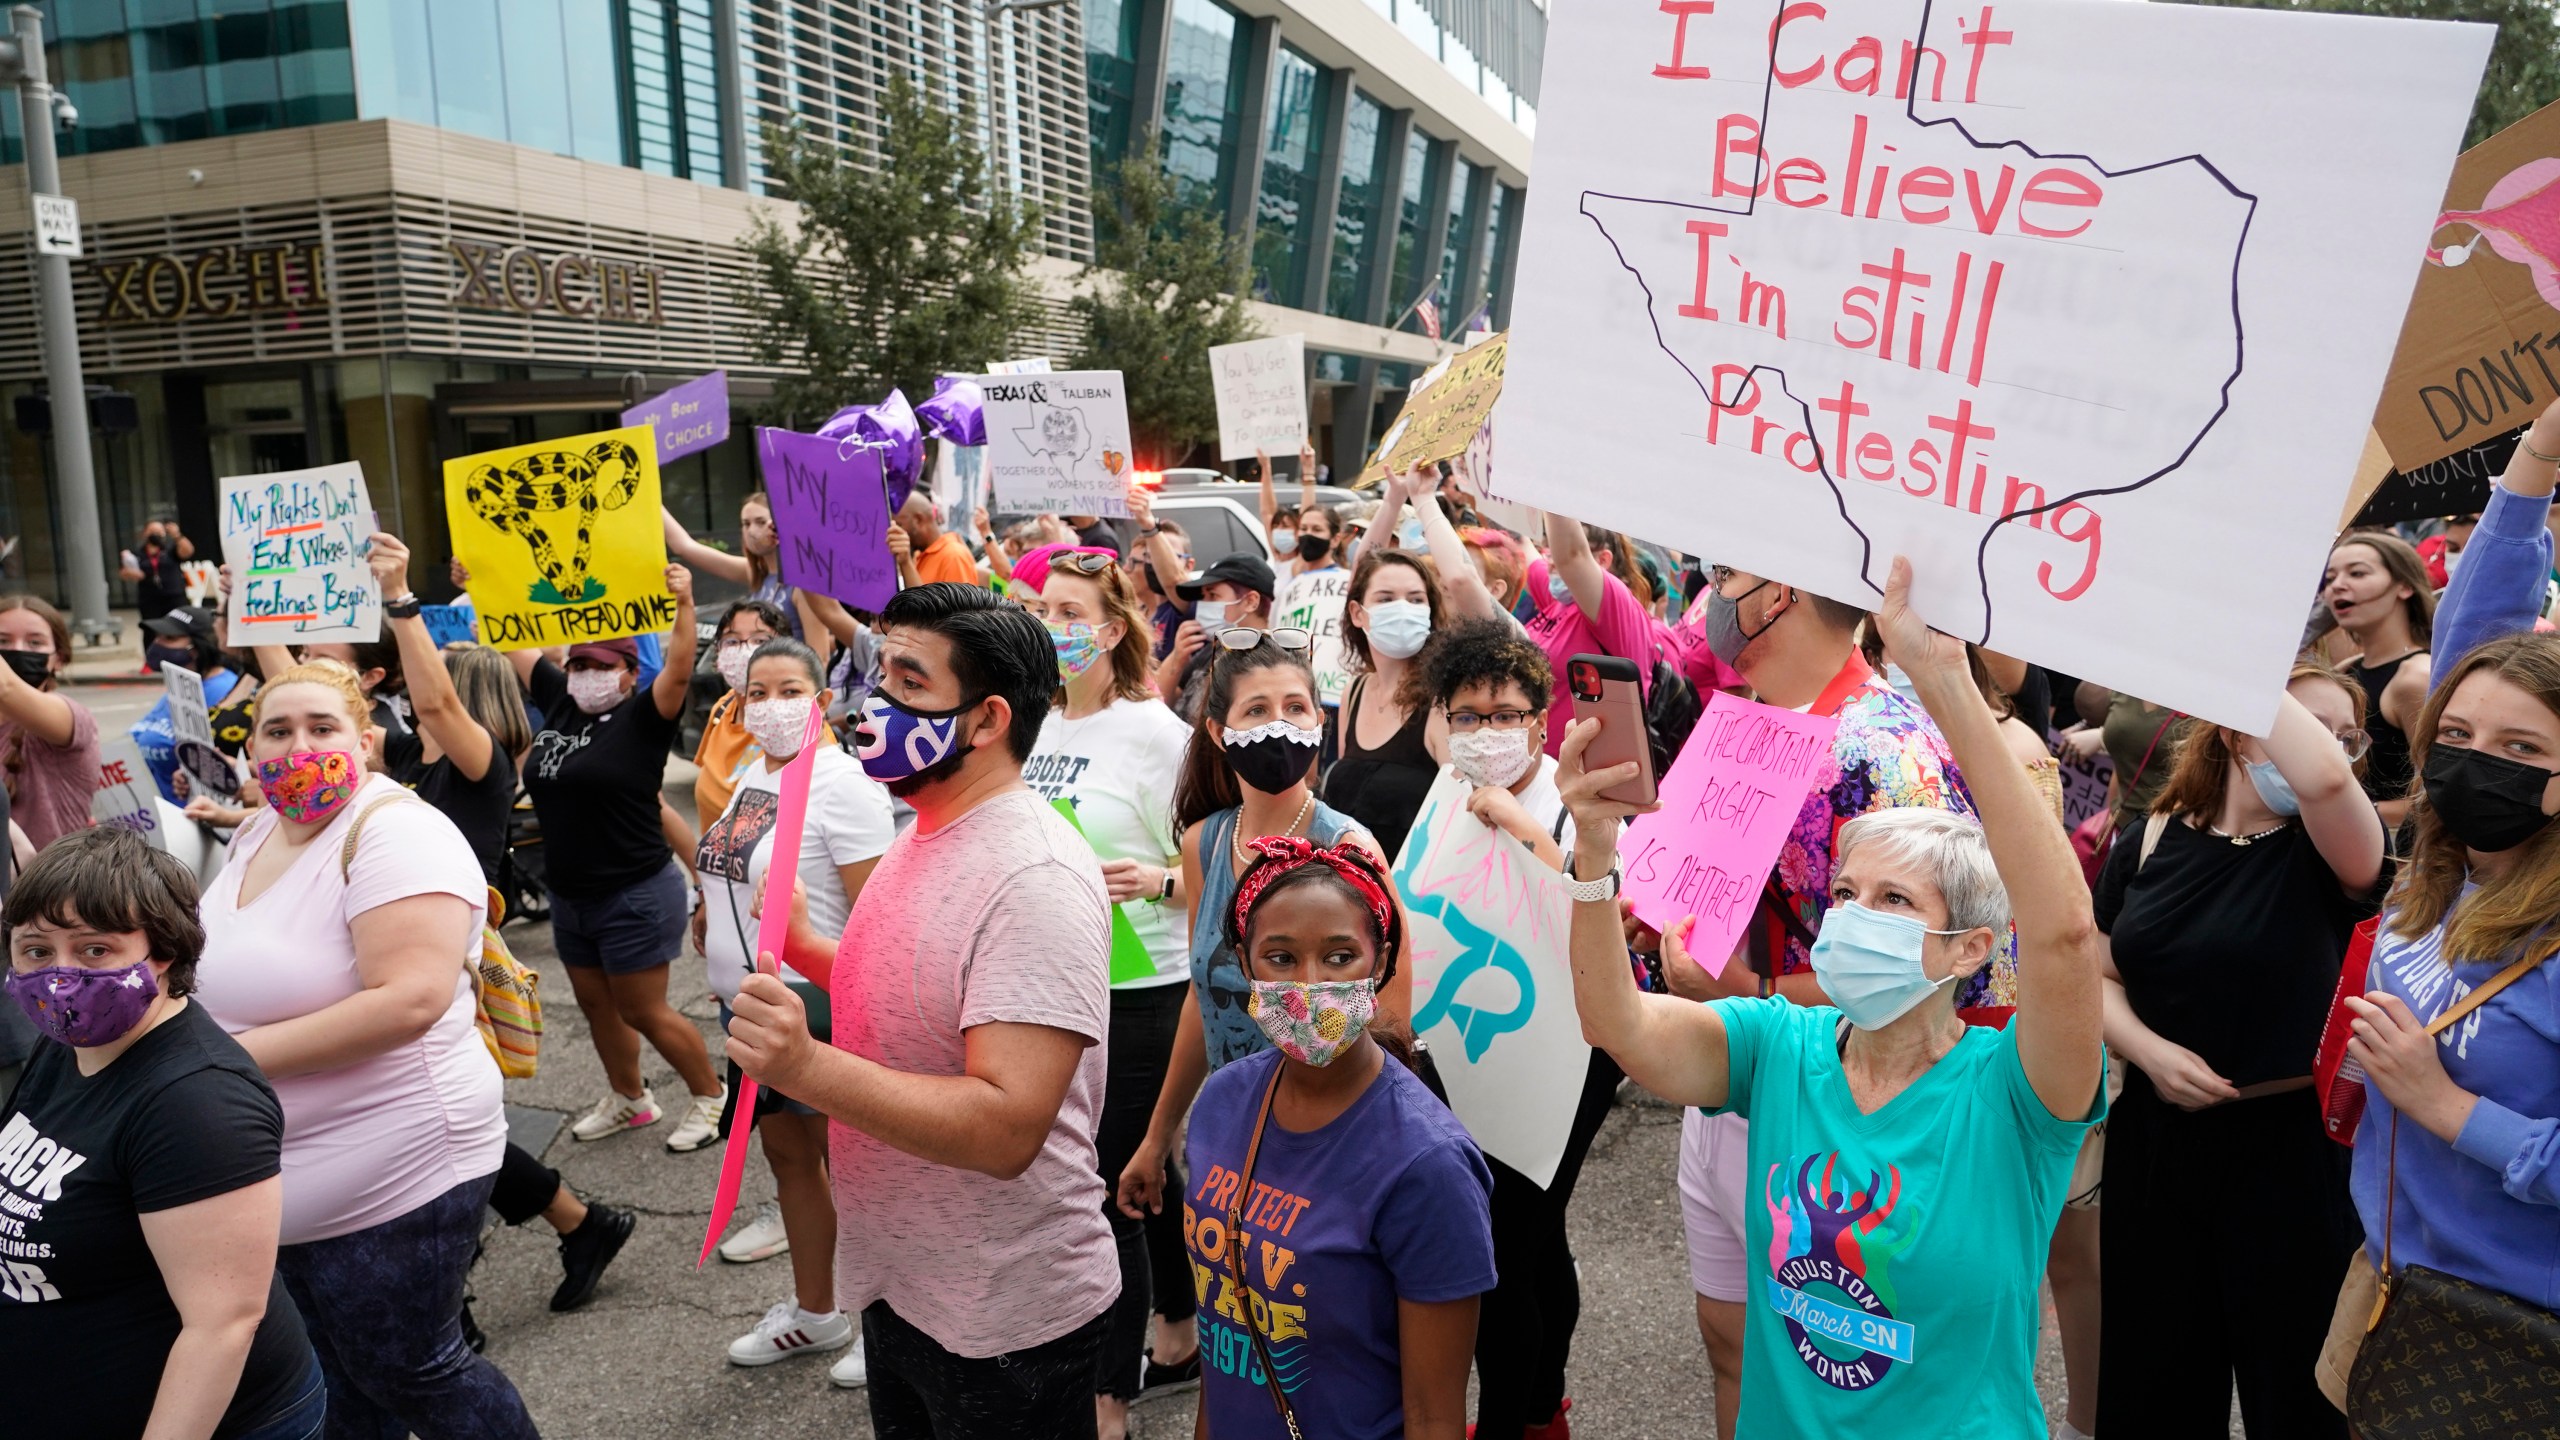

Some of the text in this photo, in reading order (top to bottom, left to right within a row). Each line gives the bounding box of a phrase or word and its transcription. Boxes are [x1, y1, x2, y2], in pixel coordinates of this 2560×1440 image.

[1652, 0, 2013, 103] I Can't
[1712, 114, 2103, 238] Believe
[41, 201, 73, 217] ONE
[42, 217, 73, 234] WAY
[95, 243, 331, 324] XOCHI
[443, 238, 665, 325] XOCHI
[1678, 220, 2004, 388] I'm still
[984, 384, 1026, 402] TEXAS
[1061, 388, 1112, 399] TALIBAN
[2419, 332, 2560, 442] DON'T
[664, 421, 714, 451] CHOICE
[994, 466, 1046, 476] TOGETHER
[1048, 479, 1095, 490] WOMEN'S
[1706, 363, 2102, 601] Protesting
[227, 490, 263, 543] My
[265, 482, 321, 537] Rights
[252, 536, 293, 571] End
[794, 535, 834, 593] MY
[246, 579, 317, 632] Feelings
[1309, 578, 1349, 598] ARE
[484, 594, 678, 645] DONT TREAD ON ME
[1704, 710, 1748, 763] THE
[1691, 776, 1777, 838] RIGHT
[1626, 837, 1667, 883] IS
[0, 1111, 88, 1201] ACK
[1196, 1164, 1312, 1237] PRTECT
[1781, 1258, 1880, 1310] HOUSTON
[1780, 1286, 1897, 1350] March ON
[1798, 1337, 1875, 1388] WOMEN
